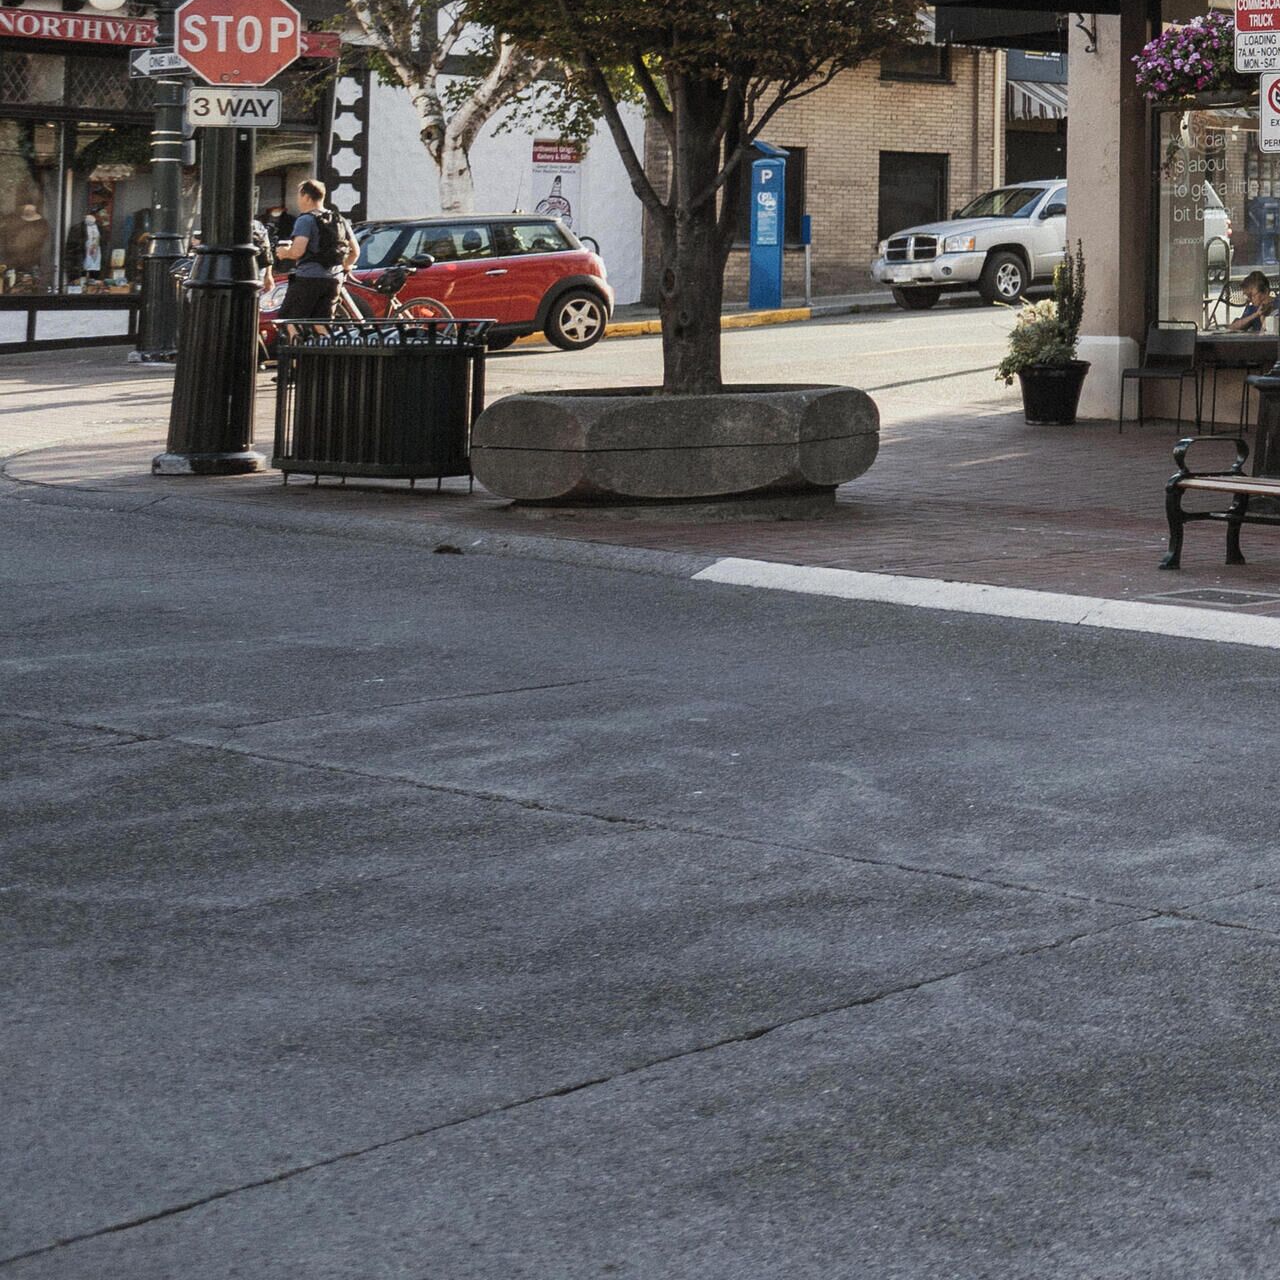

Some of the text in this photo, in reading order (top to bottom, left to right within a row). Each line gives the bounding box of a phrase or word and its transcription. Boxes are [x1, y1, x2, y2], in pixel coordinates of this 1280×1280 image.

[1249, 14, 1273, 27] TRUCK
[182, 15, 295, 53] STOP
[1244, 35, 1276, 45] LOADING
[150, 54, 165, 68] ONE
[193, 98, 275, 117] 3 WAY
[1205, 134, 1229, 151] day
[1188, 157, 1229, 172] about
[761, 169, 773, 184] P
[1174, 183, 1188, 198] to
[1218, 184, 1228, 195] a
[1174, 206, 1190, 222] bit
